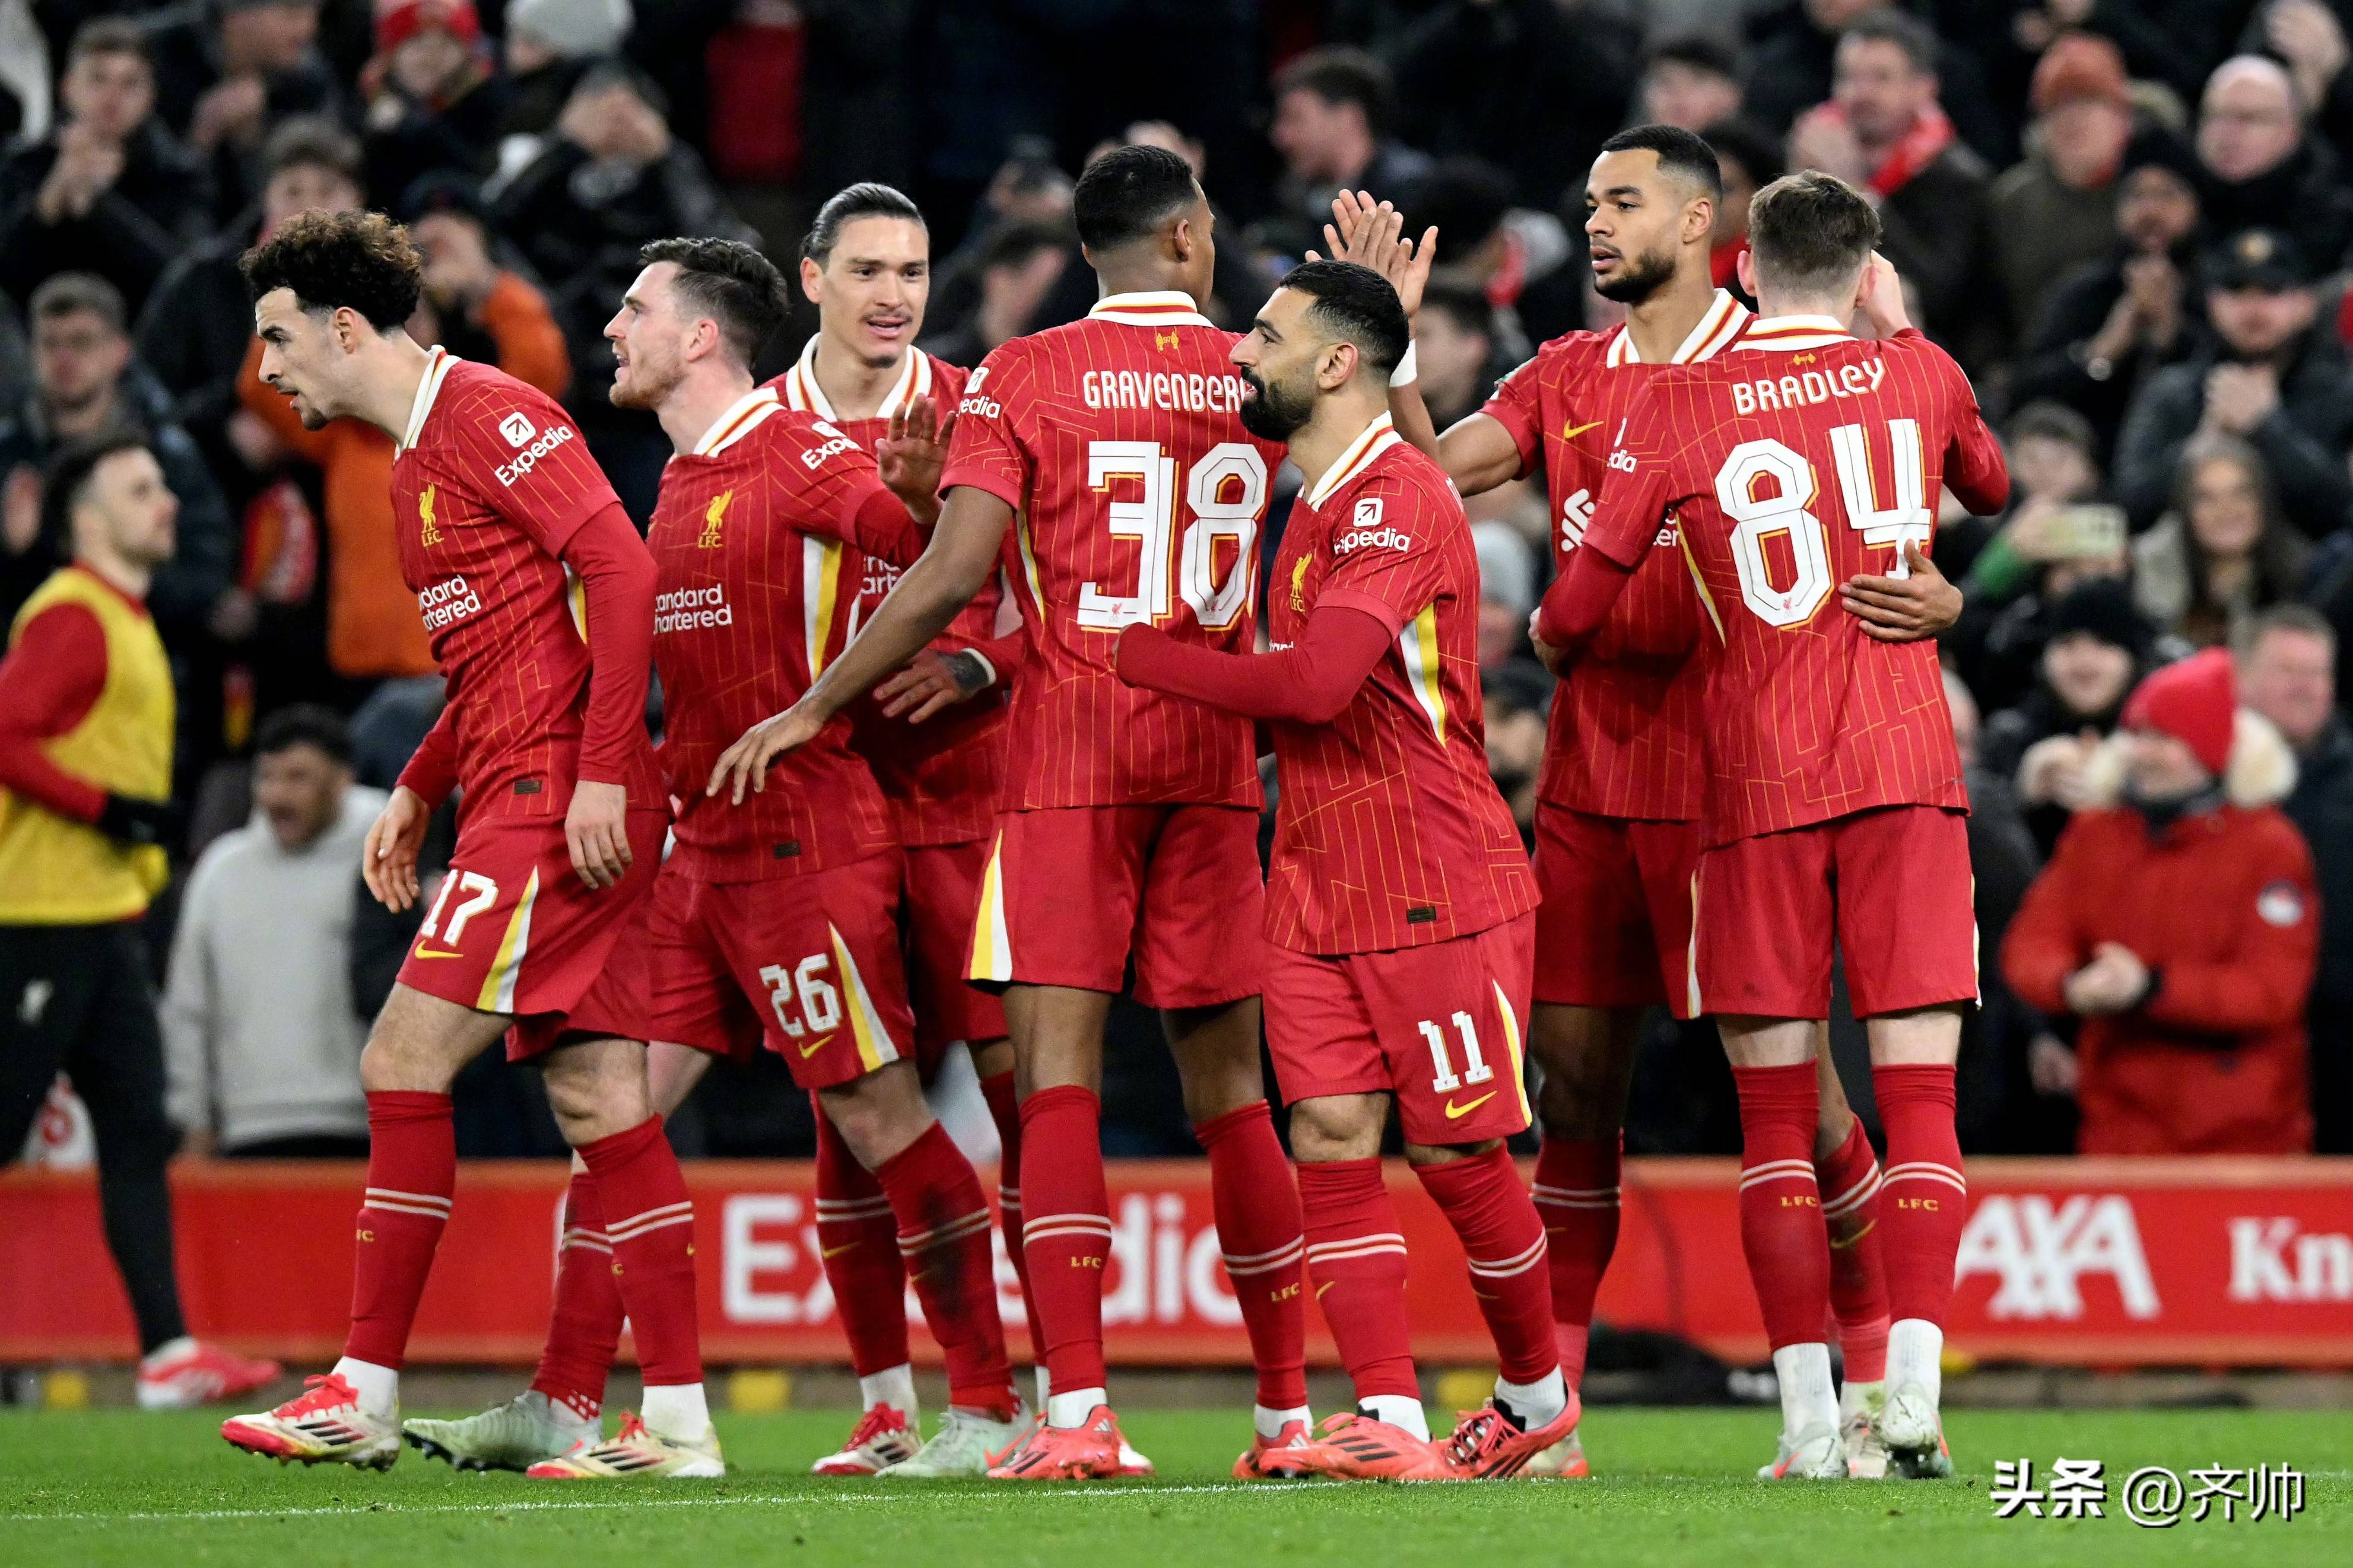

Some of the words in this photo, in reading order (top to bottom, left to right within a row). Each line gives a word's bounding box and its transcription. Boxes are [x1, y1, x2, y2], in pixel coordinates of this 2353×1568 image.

[957, 396, 1001, 419] edia
[494, 425, 574, 486] Expedia
[421, 530, 444, 547] LFC
[1077, 441, 1268, 630] 38
[1714, 418, 1932, 629] 84
[698, 535, 722, 549] LFC
[656, 583, 723, 612] andard
[653, 603, 732, 635] hartered
[420, 869, 499, 947] 17
[758, 952, 842, 1037] 26
[1418, 1010, 1494, 1093] 11
[1780, 1196, 1817, 1207] LFC
[1897, 1198, 1939, 1211] LFC
[1071, 1256, 1101, 1268] LFC
[1953, 1192, 2164, 1321] AXA
[2227, 1216, 2353, 1302] Kn
[1271, 1282, 1300, 1302] LFC
